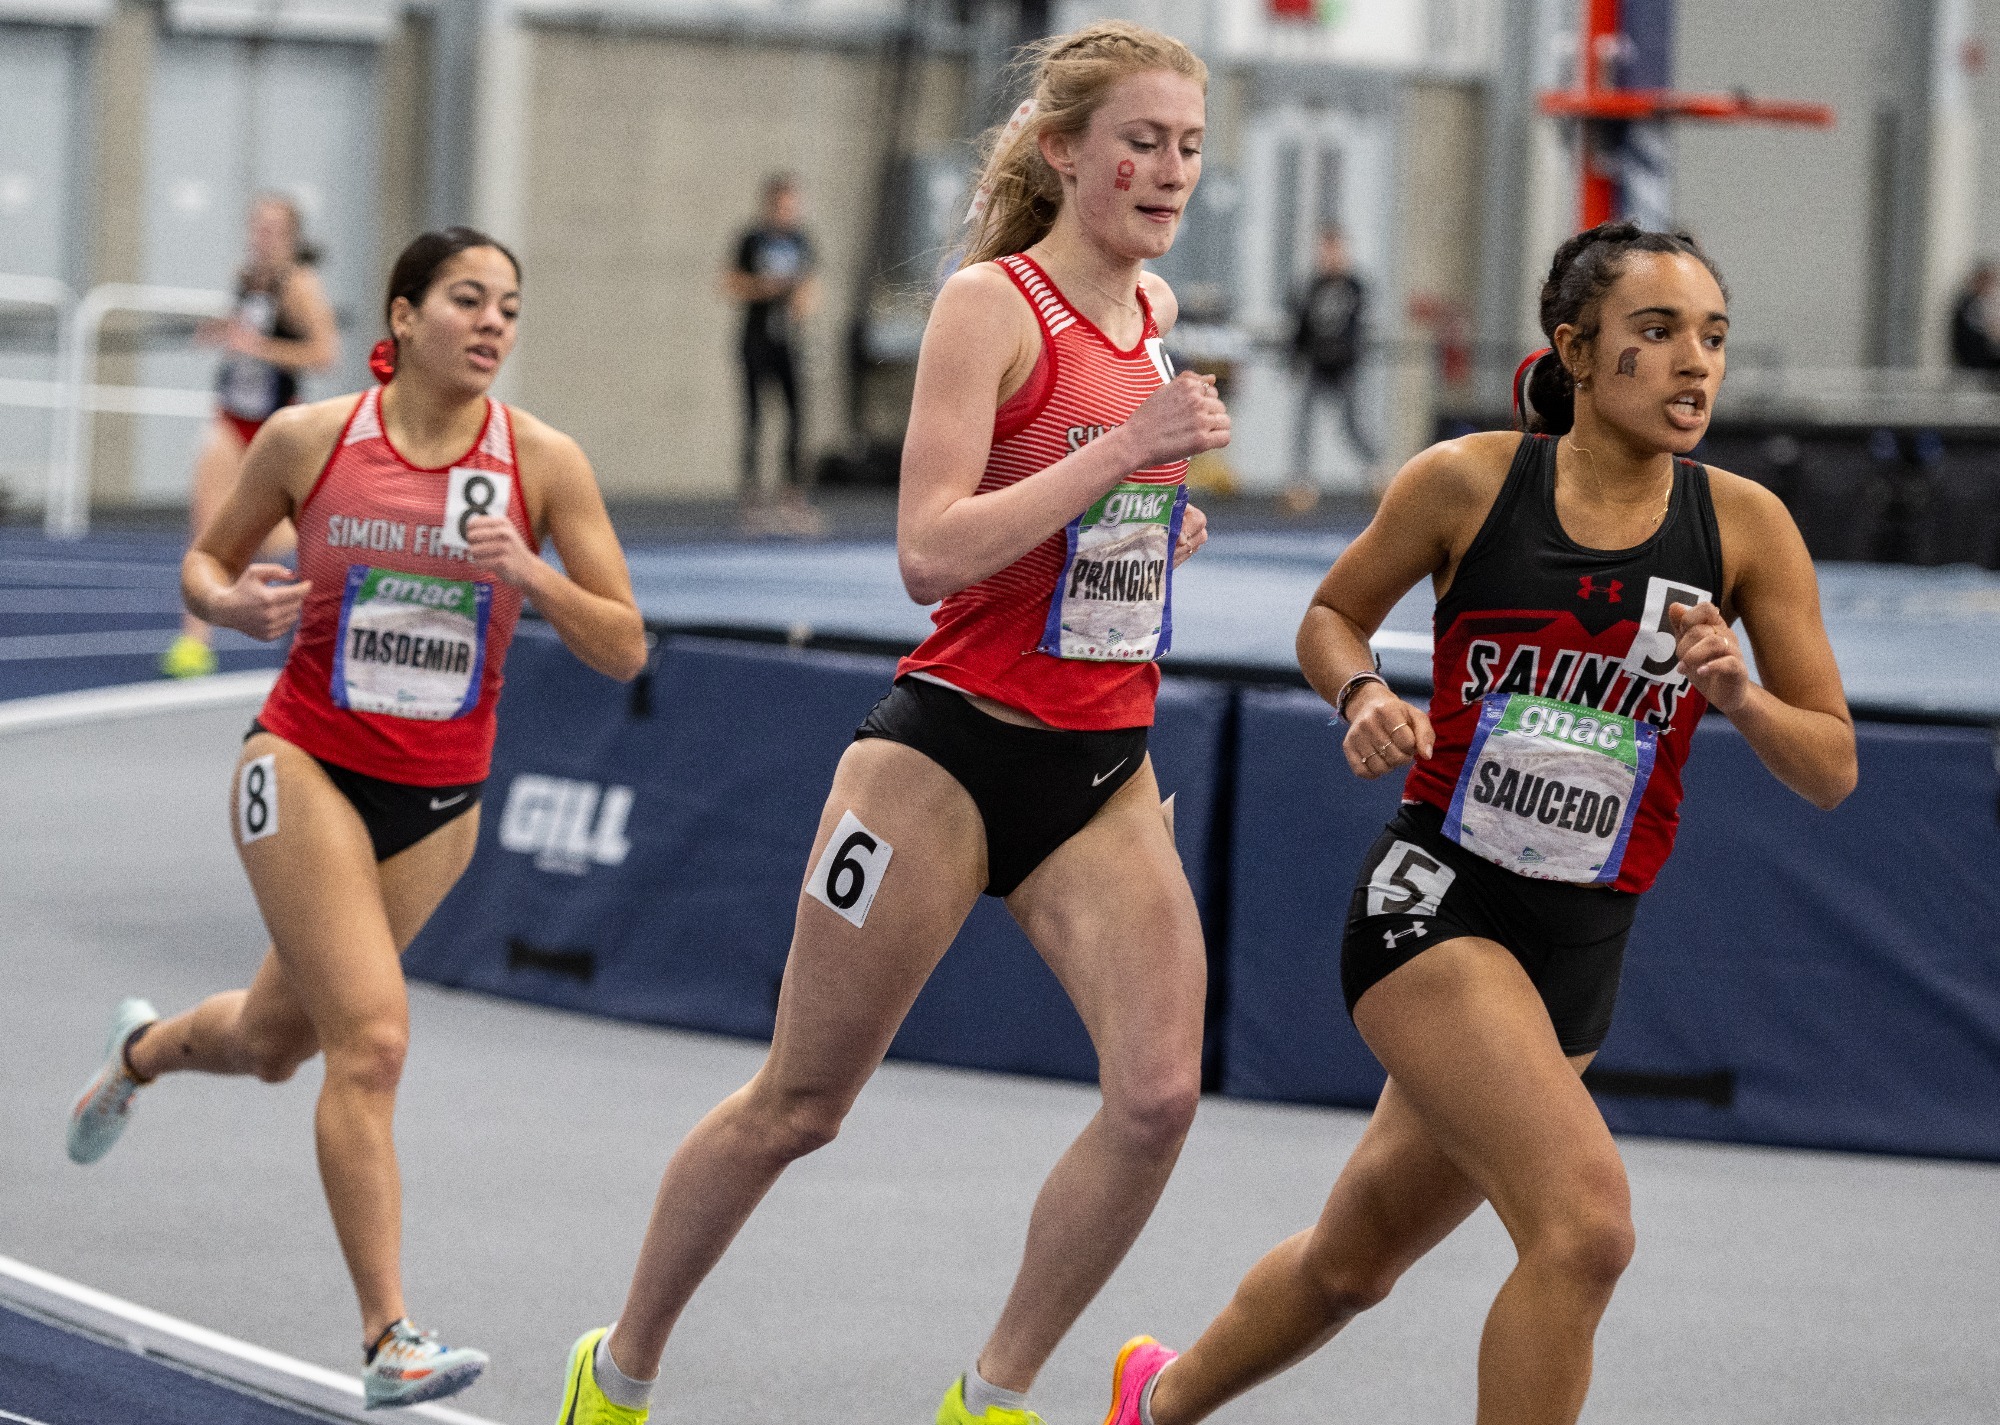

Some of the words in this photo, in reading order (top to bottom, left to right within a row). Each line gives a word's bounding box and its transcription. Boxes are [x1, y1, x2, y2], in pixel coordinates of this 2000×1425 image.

[327, 514, 406, 552] SIMON
[1100, 492, 1169, 527] gnac
[375, 577, 464, 607] gnac
[1069, 559, 1164, 601] PRANGLEY
[352, 628, 470, 673] TASDEMIR
[1641, 587, 1699, 675] 5
[1461, 639, 1691, 735] SAINTS
[1515, 704, 1624, 750] gnac
[247, 765, 267, 834] 8
[500, 774, 635, 865] GILL
[1473, 761, 1621, 839] SAUCEDO
[826, 831, 877, 909] 6
[1381, 849, 1440, 913] 5
